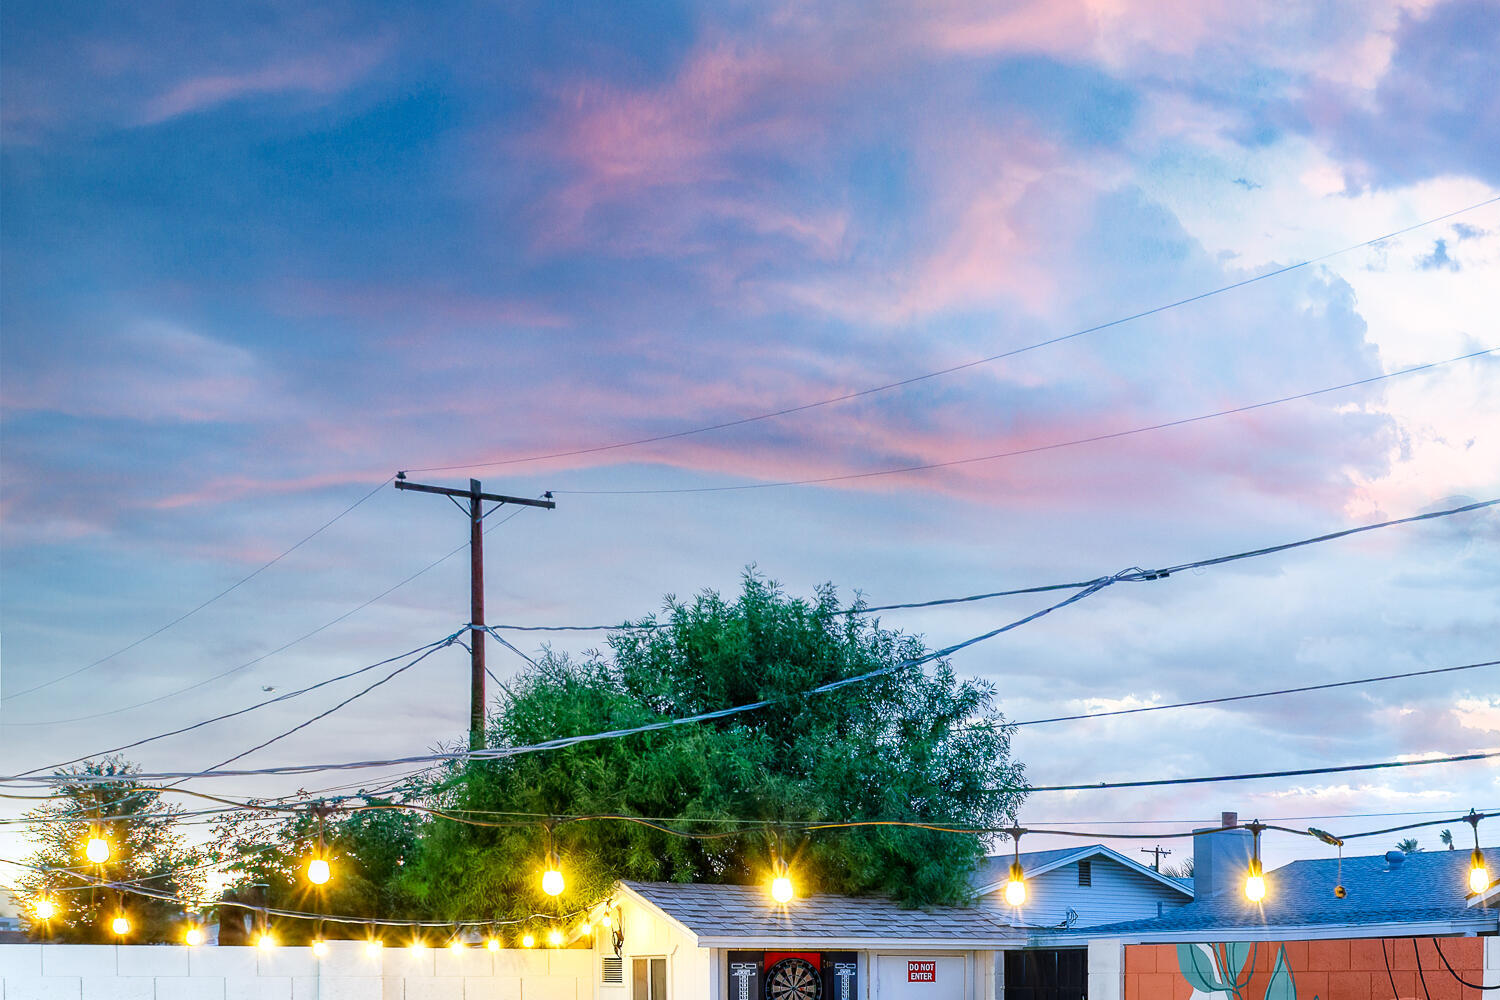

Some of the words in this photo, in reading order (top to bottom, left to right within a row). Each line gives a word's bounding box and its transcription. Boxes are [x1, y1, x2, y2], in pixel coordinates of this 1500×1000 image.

[910, 963, 919, 971] DO
[921, 963, 934, 971] NOT
[911, 972, 933, 980] ENTER
